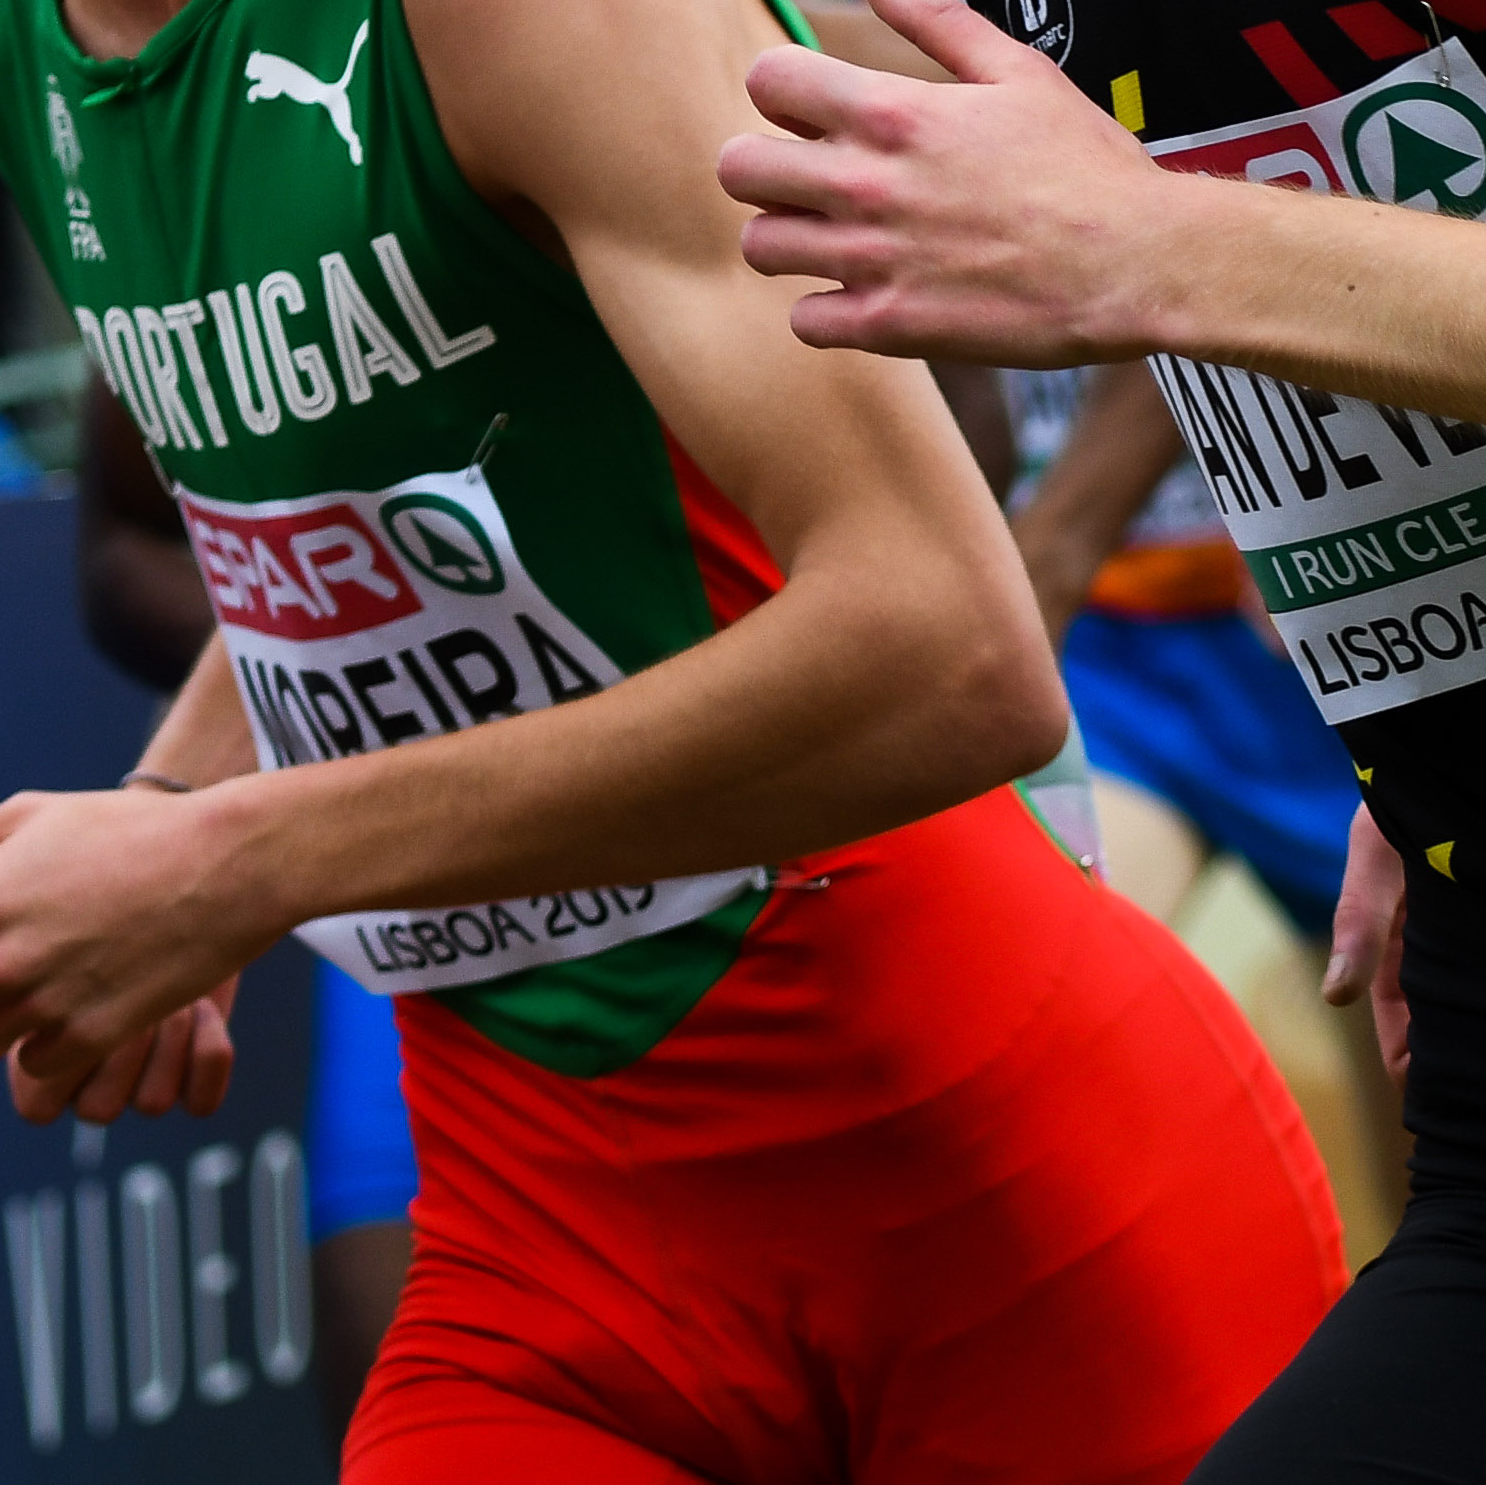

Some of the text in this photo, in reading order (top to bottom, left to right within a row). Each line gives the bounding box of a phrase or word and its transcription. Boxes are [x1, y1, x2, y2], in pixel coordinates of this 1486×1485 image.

[74, 232, 498, 451] PORTUGAL
[196, 518, 399, 618] SPAR
[1271, 556, 1295, 600] I
[1291, 533, 1396, 596] RUN
[237, 612, 607, 771] MOREIRA
[355, 902, 537, 973] LISBOA
